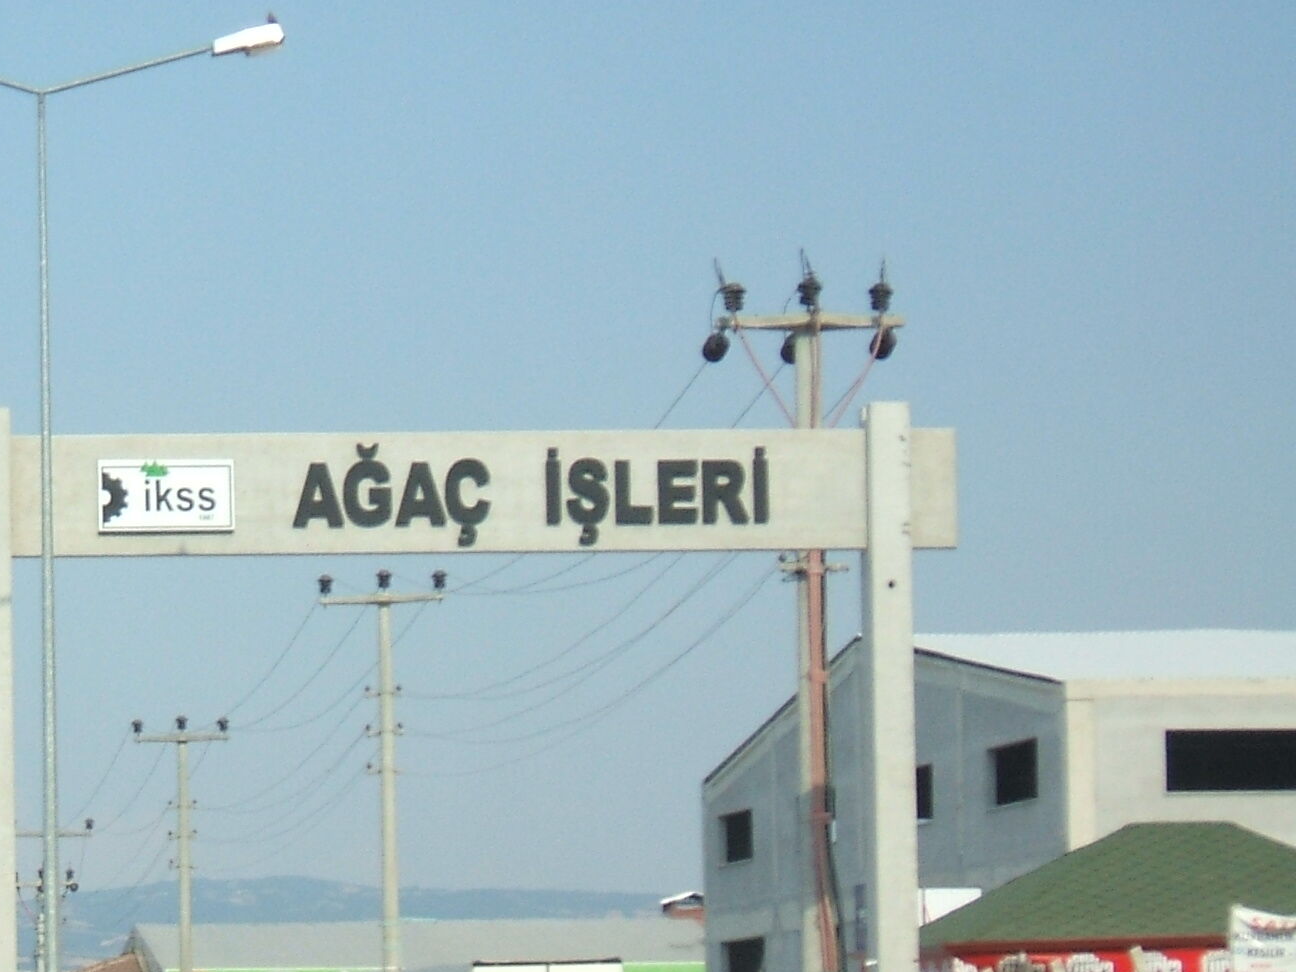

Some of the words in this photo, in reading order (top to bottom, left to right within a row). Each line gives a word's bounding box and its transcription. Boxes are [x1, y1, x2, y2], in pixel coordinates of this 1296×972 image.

[144, 479, 216, 512] ikss
[292, 443, 490, 547] AĞAÇ
[545, 446, 769, 547] İŞLERİ
